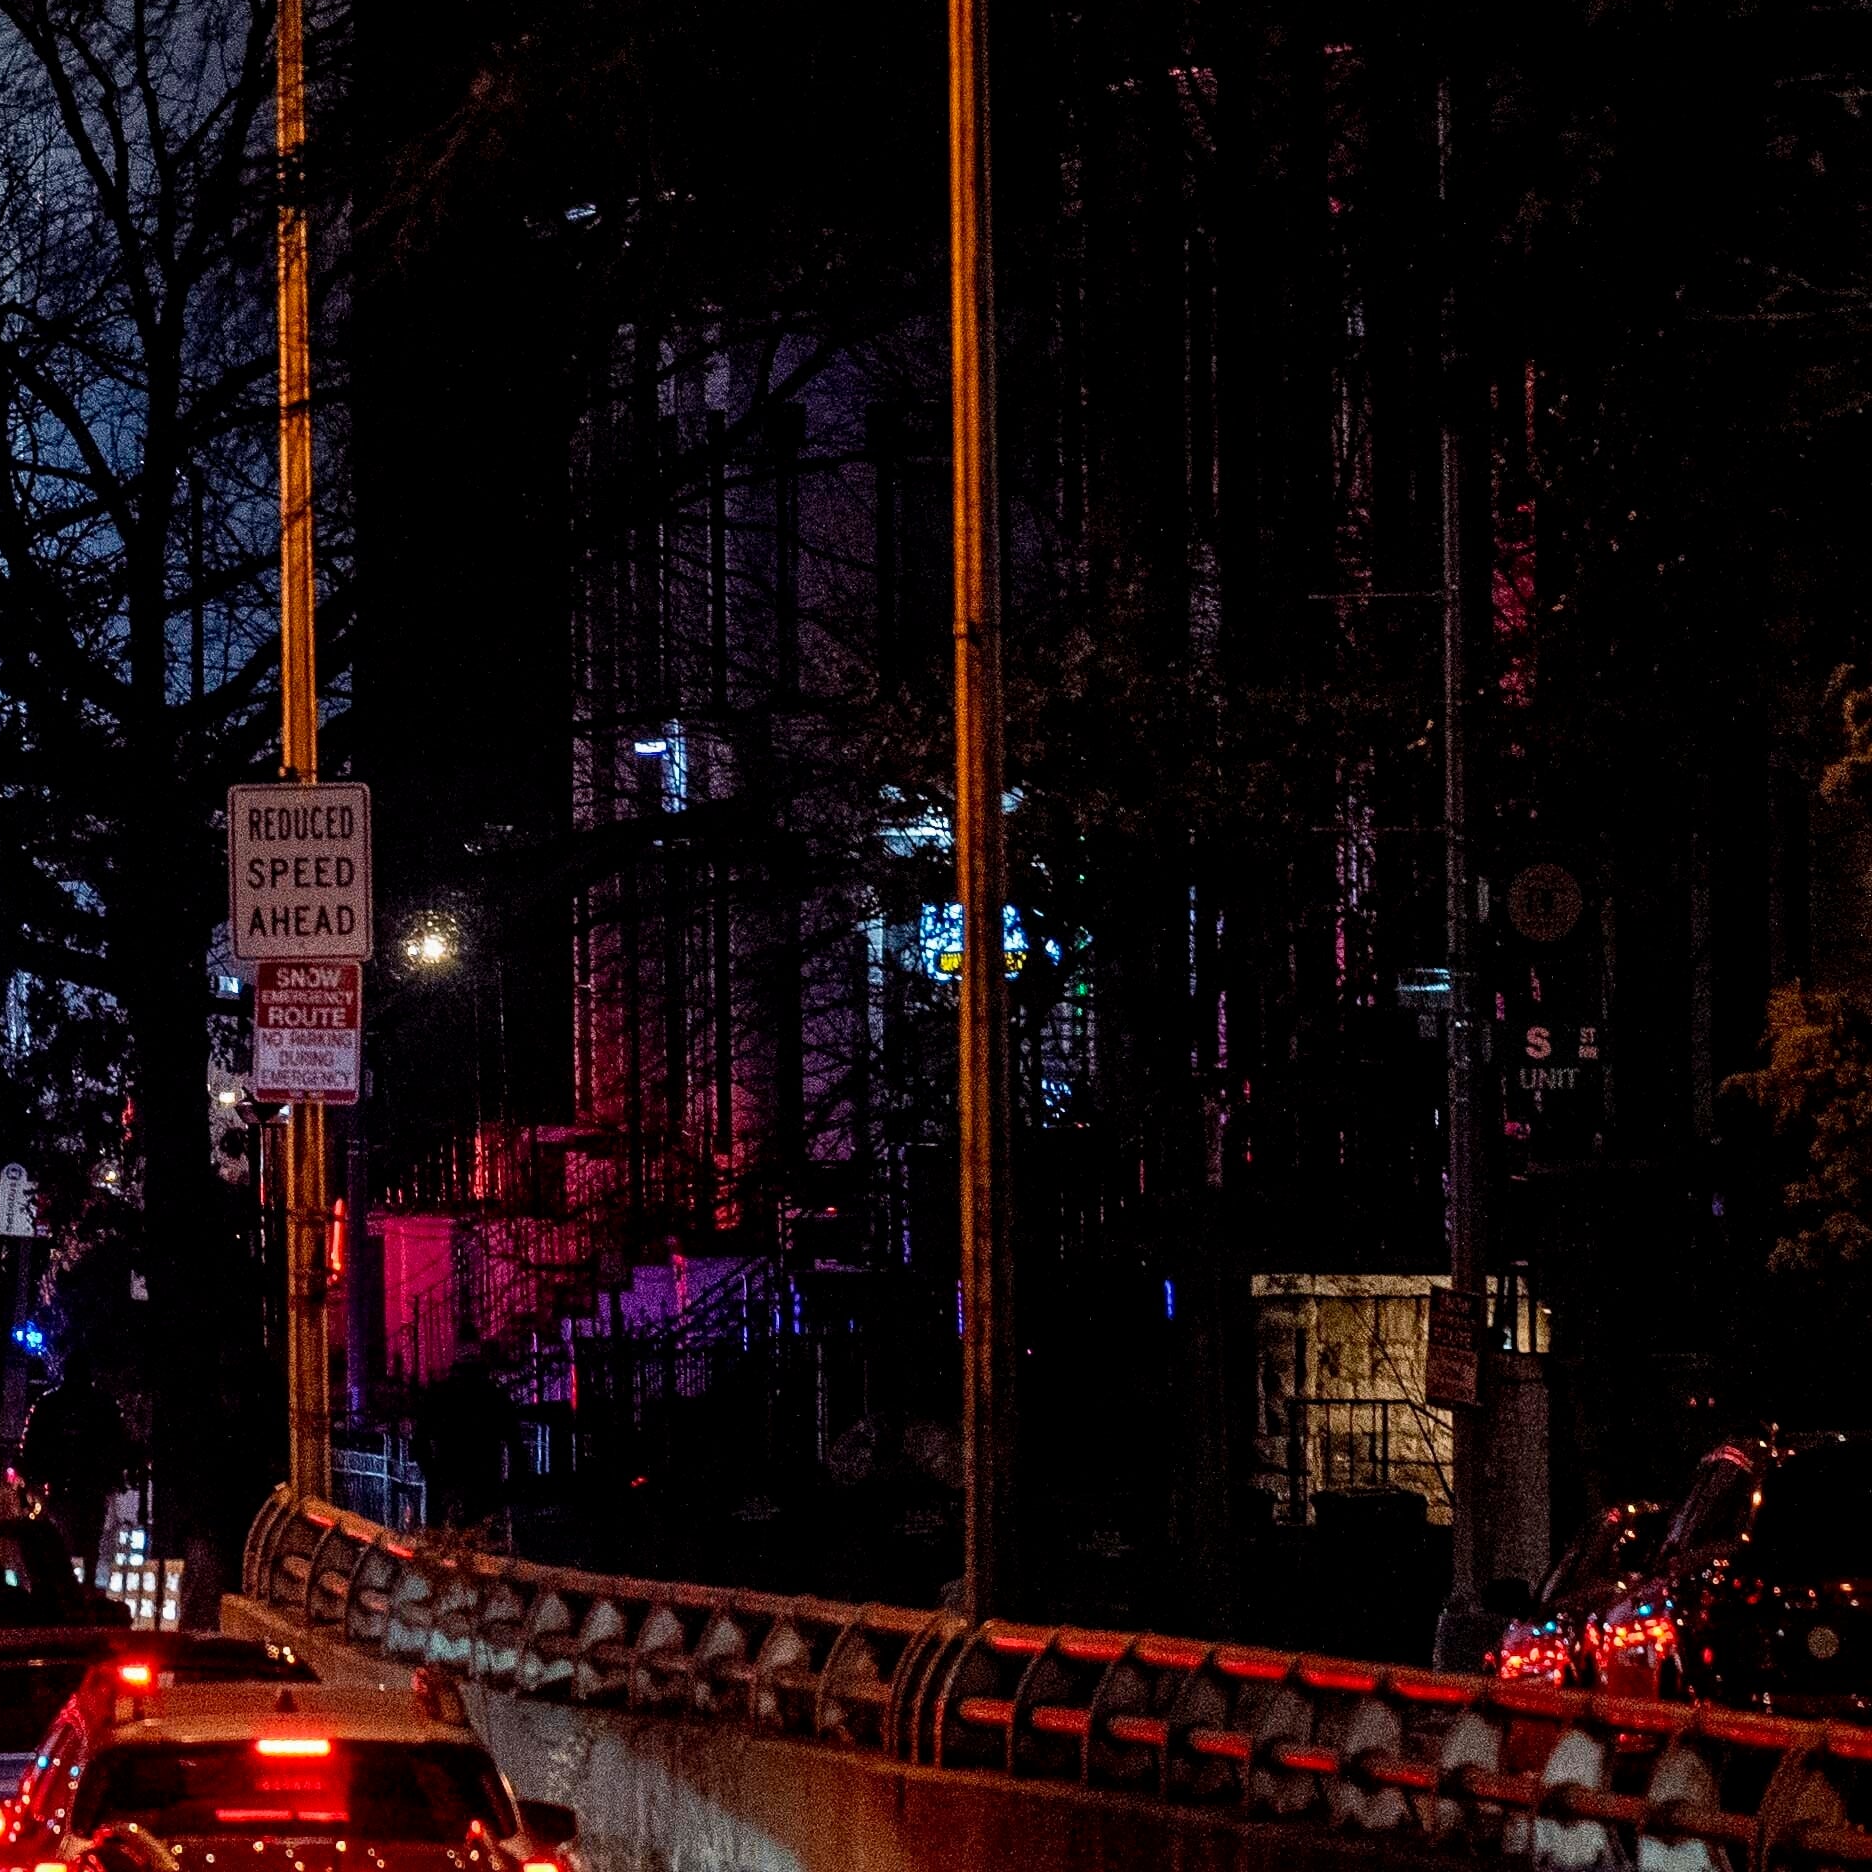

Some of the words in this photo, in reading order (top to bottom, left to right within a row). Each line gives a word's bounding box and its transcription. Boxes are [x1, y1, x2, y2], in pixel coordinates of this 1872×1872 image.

[249, 807, 354, 841] REDUCED
[247, 857, 354, 888] SPEED
[248, 905, 354, 936] AHEAD
[276, 967, 341, 987] SNOW
[261, 991, 353, 1004] EMERGENCY
[268, 1007, 347, 1027] ROUTE
[262, 1032, 283, 1047] NO
[290, 1032, 352, 1048] PARKING
[1525, 1025, 1553, 1060] S
[279, 1051, 334, 1066] DURING
[261, 1070, 351, 1086] EMERGENCY
[1518, 1067, 1581, 1090] UNIT
